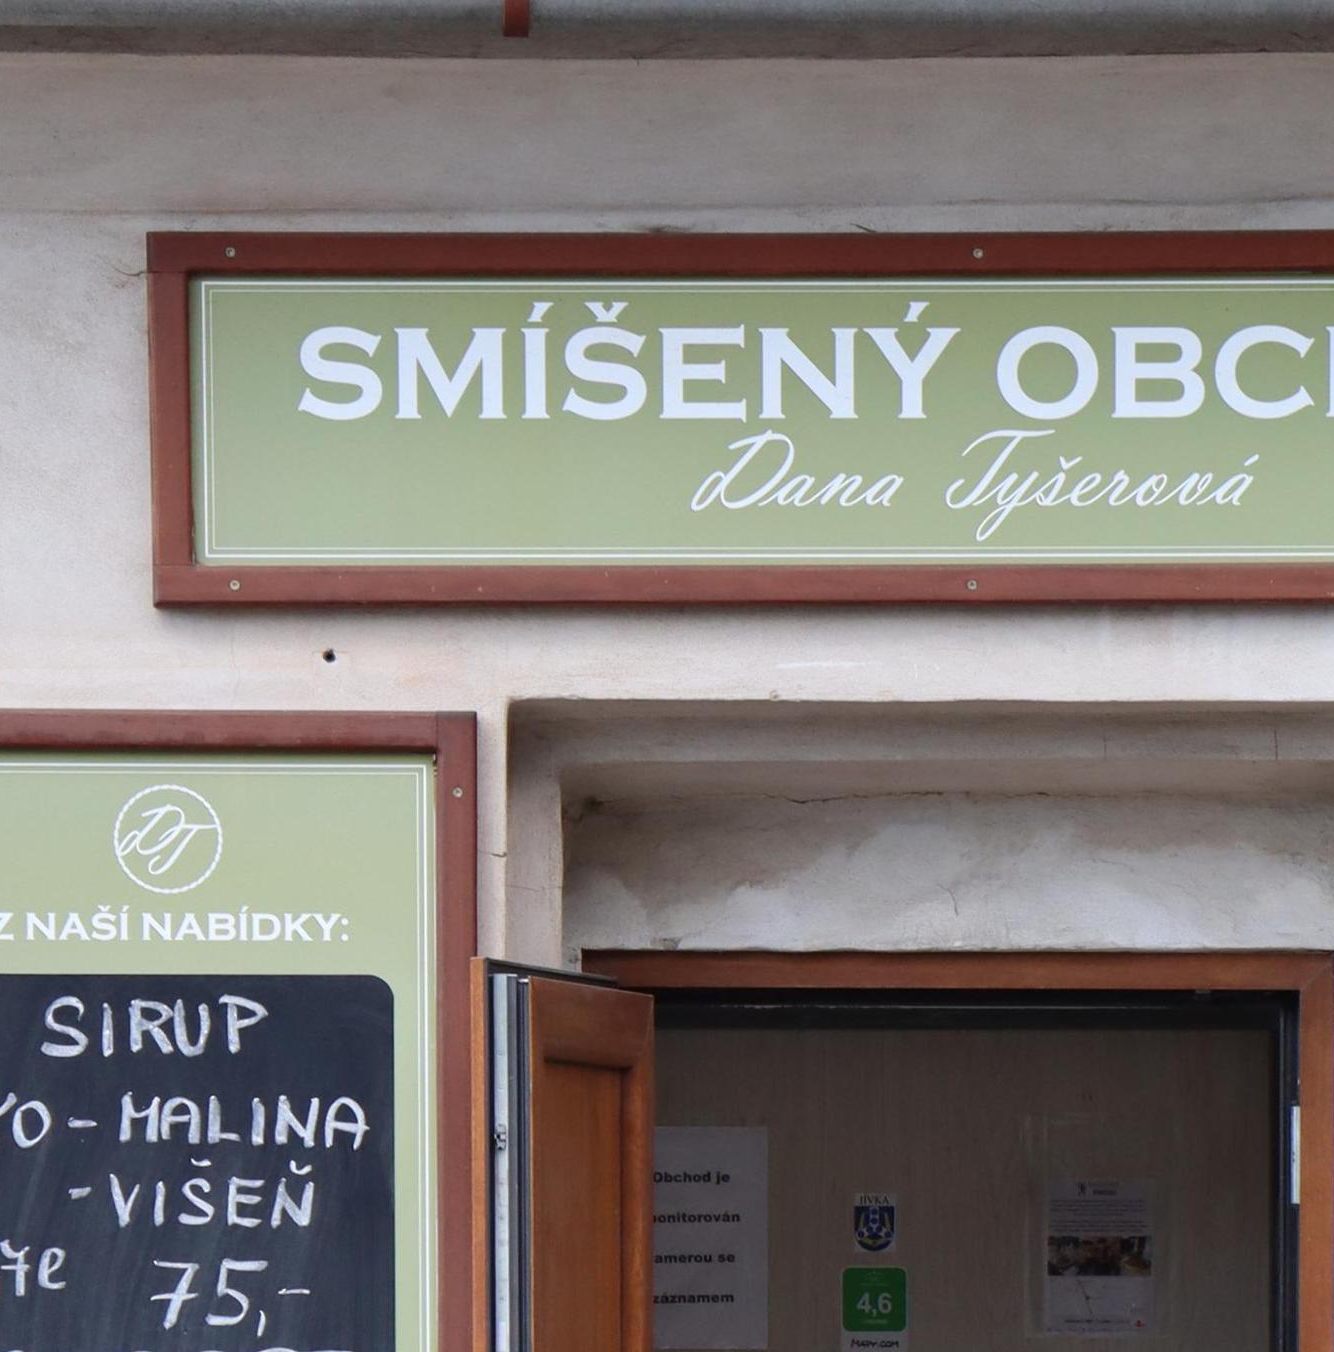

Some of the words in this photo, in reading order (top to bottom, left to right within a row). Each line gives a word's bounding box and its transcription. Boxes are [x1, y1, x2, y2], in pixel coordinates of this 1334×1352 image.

[299, 300, 968, 421] SMÍŠENÝ
[691, 429, 904, 511] Dana
[945, 429, 1259, 542] Tyšerová
[26, 906, 129, 941] NAŠÍ
[142, 906, 349, 941] NABÍDKY:
[40, 995, 268, 1057] SIRUP
[119, 1092, 369, 1150] MALINA
[653, 1172, 711, 1183] Obchod
[716, 1172, 730, 1184] je
[655, 1254, 712, 1263] amerou
[718, 1254, 735, 1263] se
[653, 1293, 734, 1304] záznamem
[856, 1291, 892, 1318] 4,6
